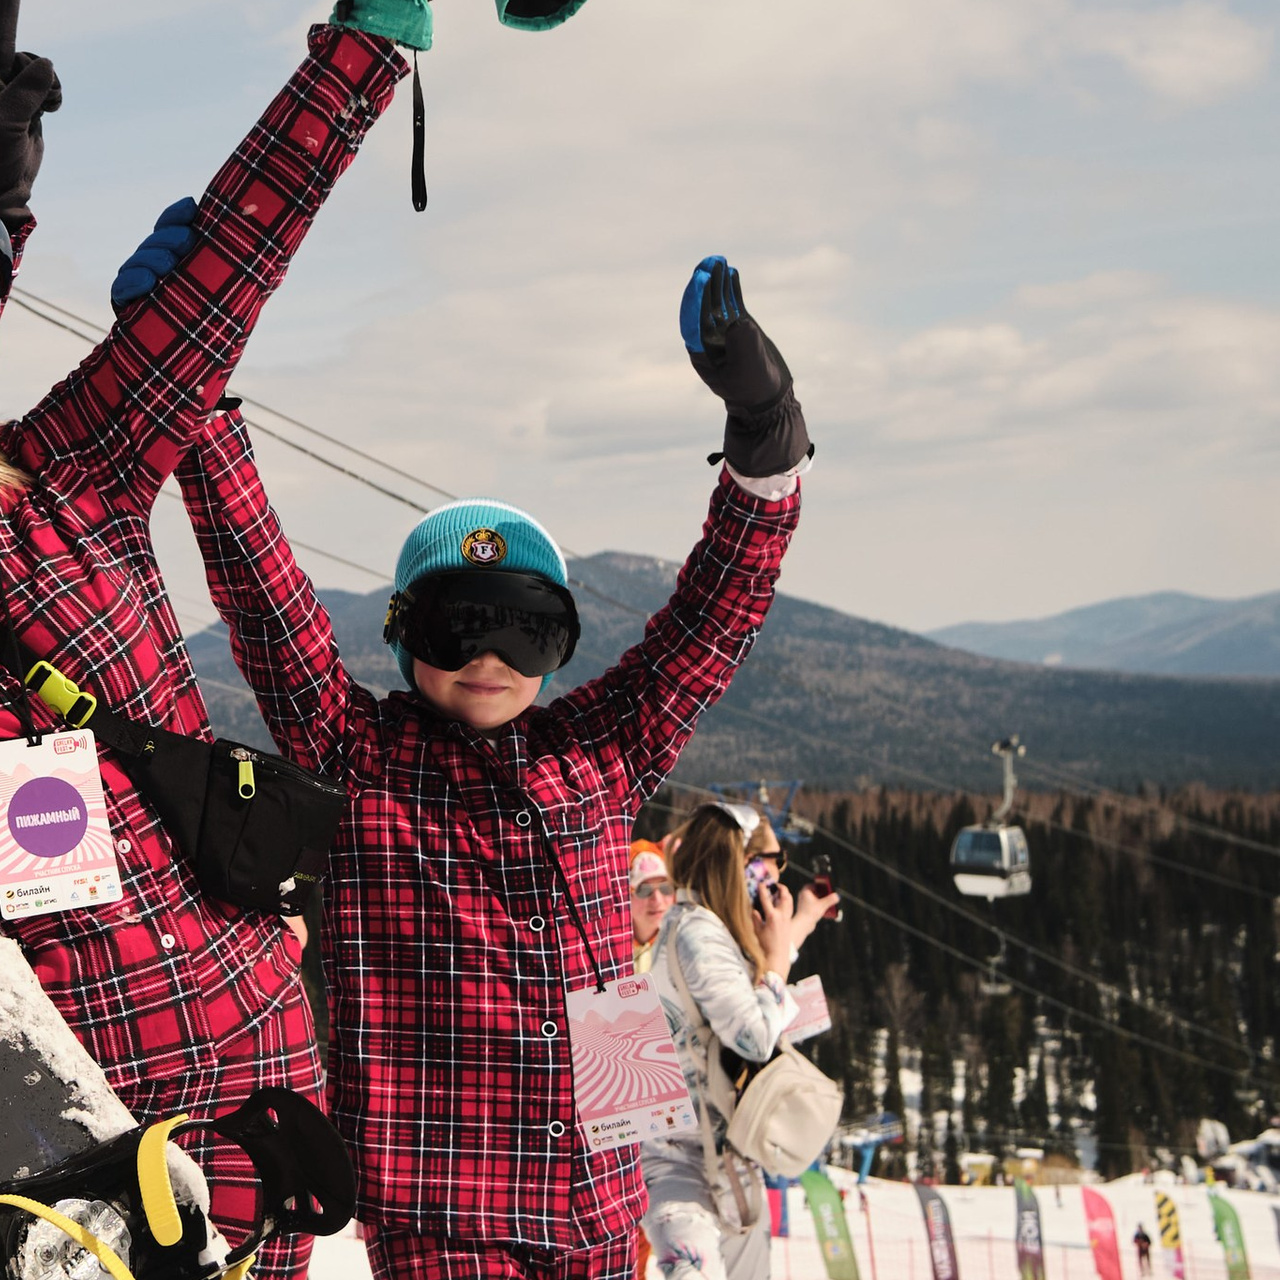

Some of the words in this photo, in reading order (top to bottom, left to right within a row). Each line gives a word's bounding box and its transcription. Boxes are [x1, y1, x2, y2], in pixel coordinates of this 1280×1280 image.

[481, 546, 489, 554] F
[15, 806, 81, 829] ПИЖАМНЫЙ
[16, 885, 51, 898] билайн
[600, 1119, 632, 1131] билайн
